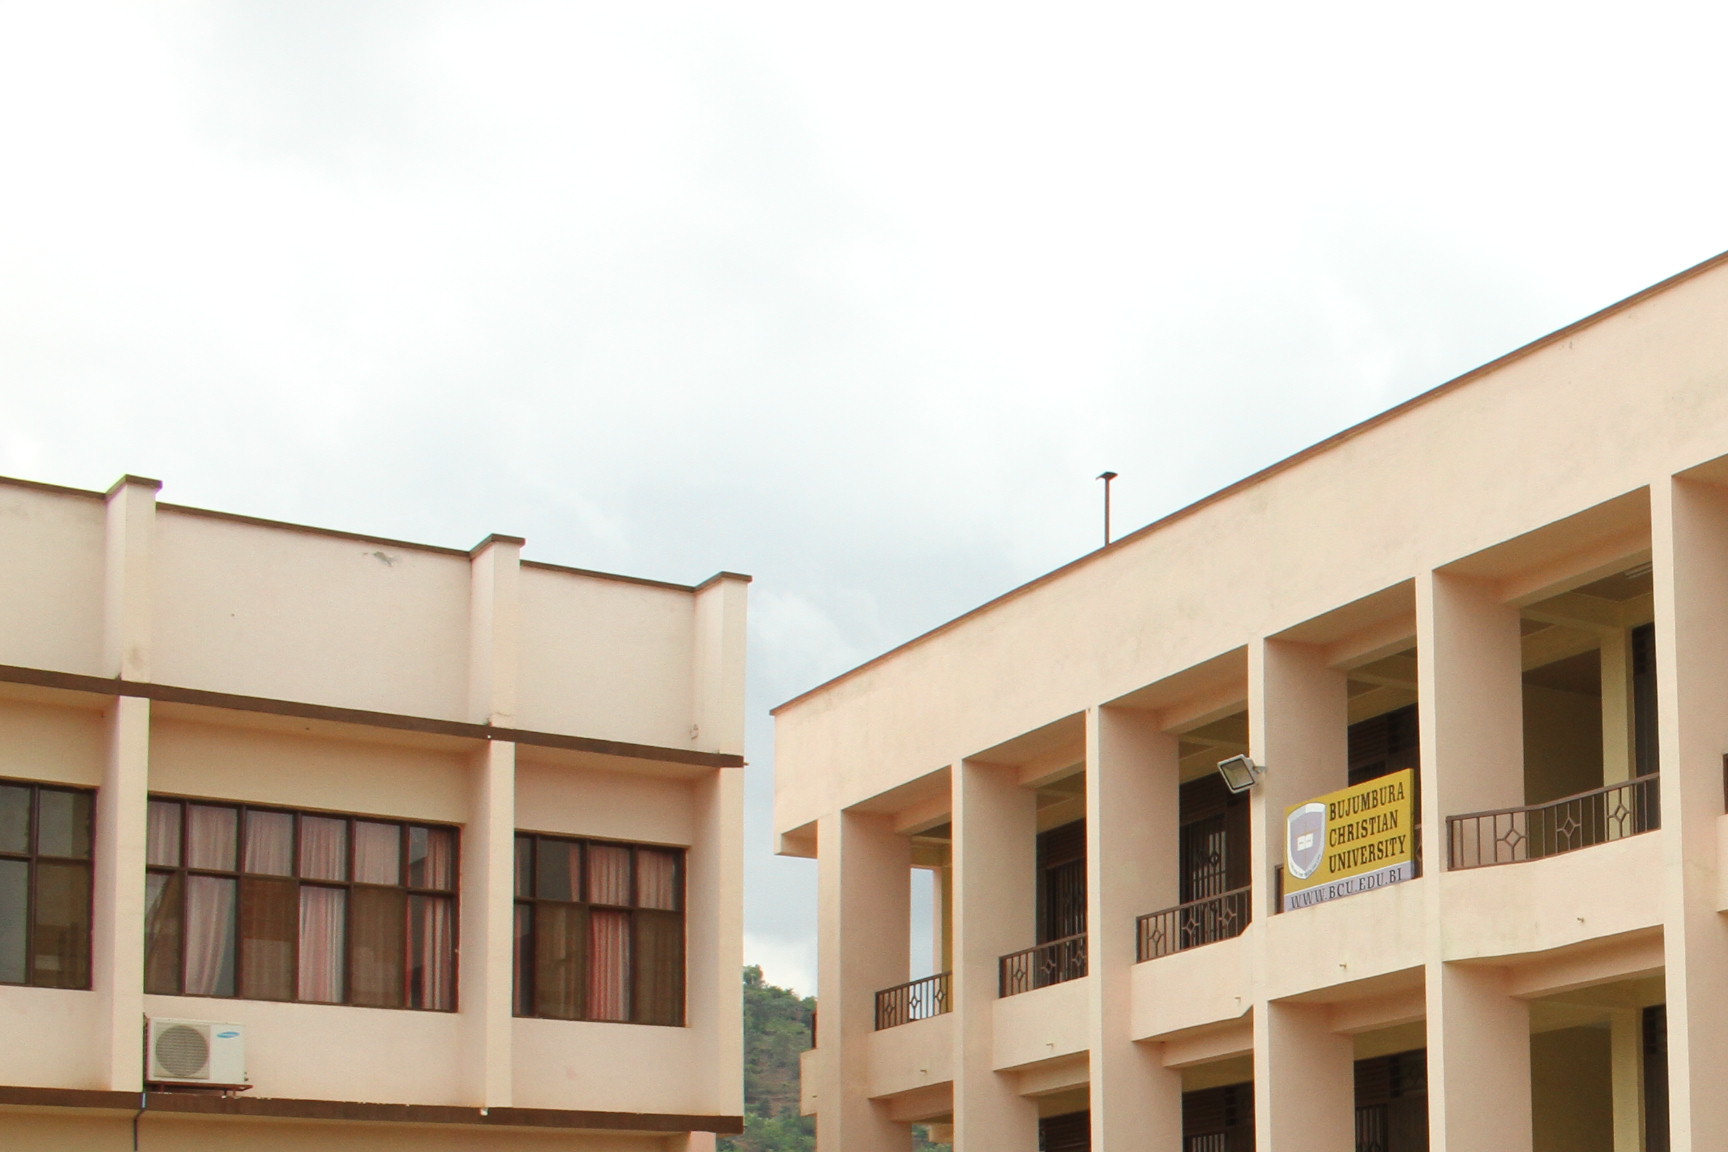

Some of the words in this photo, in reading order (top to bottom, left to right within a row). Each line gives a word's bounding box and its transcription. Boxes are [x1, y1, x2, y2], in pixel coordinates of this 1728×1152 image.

[1329, 782, 1405, 821] BUJUMBURA
[1329, 810, 1398, 847] CHRISTIAN
[1329, 835, 1406, 873] UNIVERSITY
[1291, 868, 1402, 909] WWW.BCU.EDU.BI
